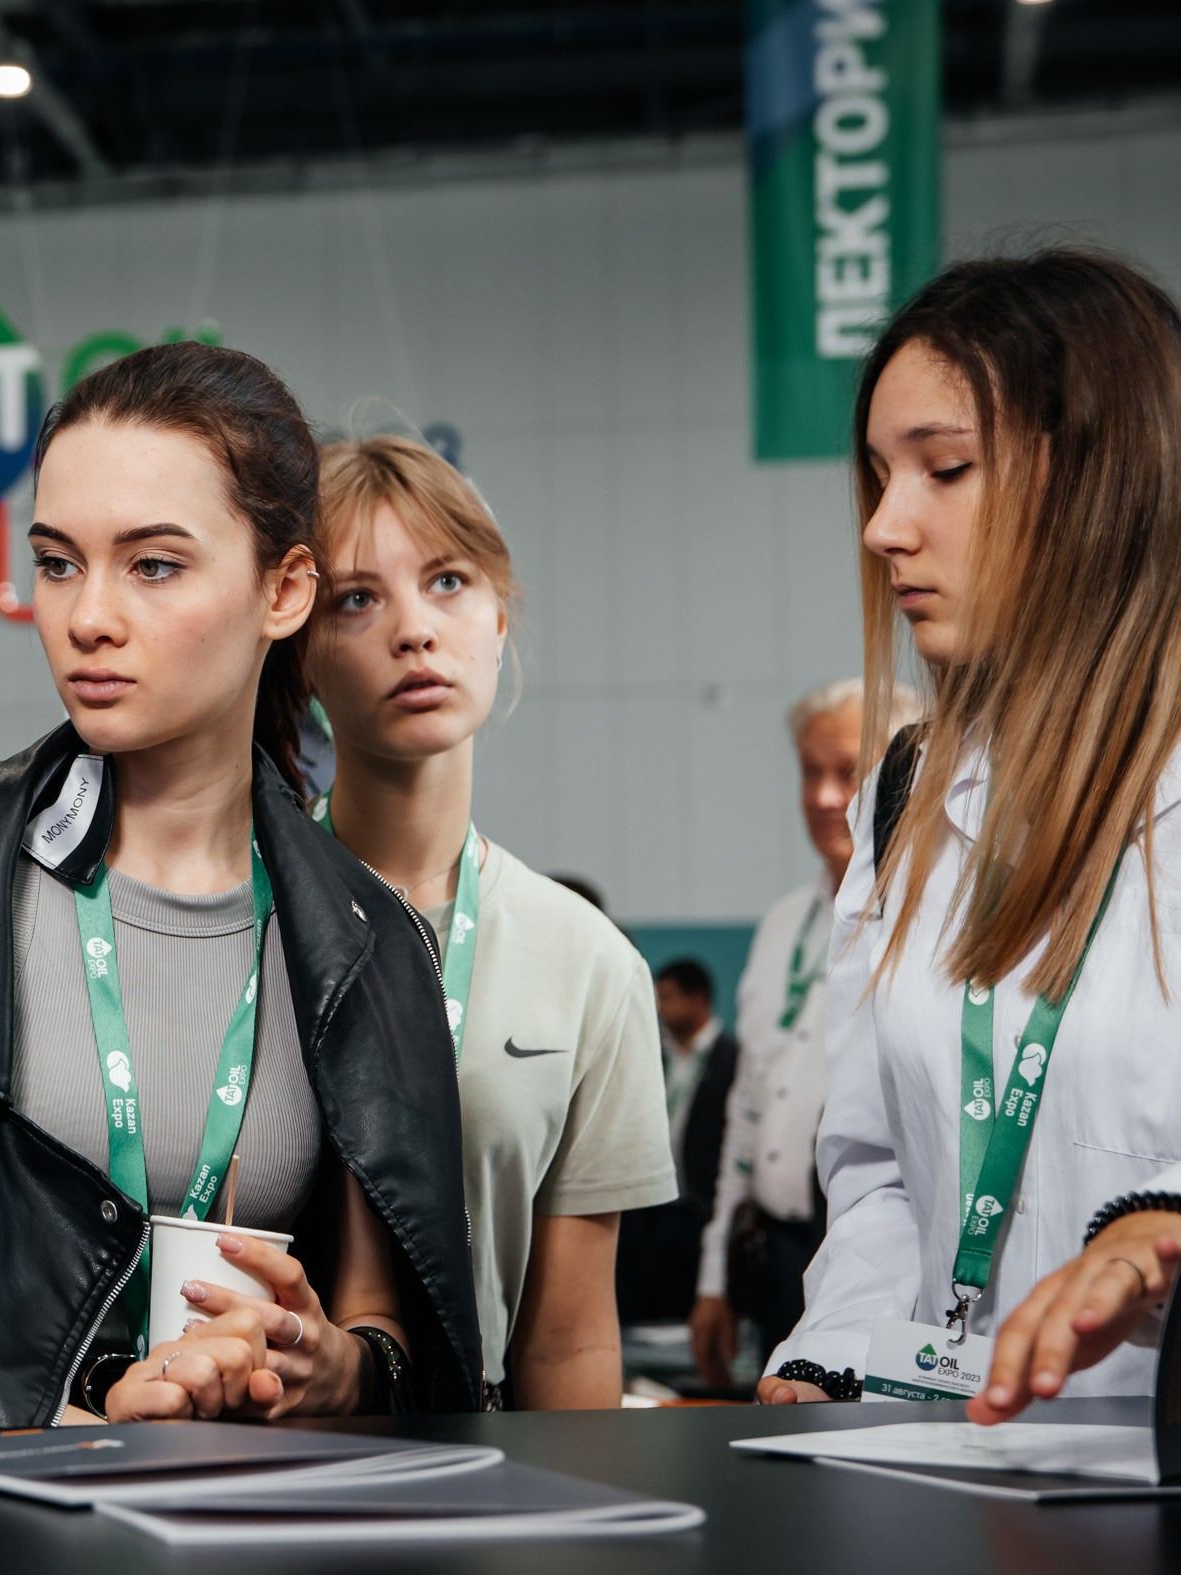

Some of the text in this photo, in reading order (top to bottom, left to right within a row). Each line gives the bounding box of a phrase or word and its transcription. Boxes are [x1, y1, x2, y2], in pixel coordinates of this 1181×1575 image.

[41, 777, 89, 844] MONYMONY
[92, 939, 108, 978] TAT OIL
[224, 1064, 240, 1102] TAT OIL
[238, 1064, 247, 1085] EXPO
[983, 1077, 992, 1098] EXPO
[111, 1098, 124, 1128] Expo
[973, 1077, 984, 1118] TAT OIL
[1005, 1088, 1024, 1117] Expo
[1017, 1091, 1038, 1127] Kazan
[125, 1098, 137, 1134] Kazan
[189, 1164, 211, 1199] Kazan
[199, 1175, 218, 1204] Expo
[974, 1199, 996, 1236] TAT OIL
[918, 1352, 960, 1371] TAT OIL
[937, 1367, 960, 1379] EXPO
[961, 1372, 981, 1383] 2023
[881, 1383, 892, 1393] 31
[893, 1386, 926, 1400] августа
